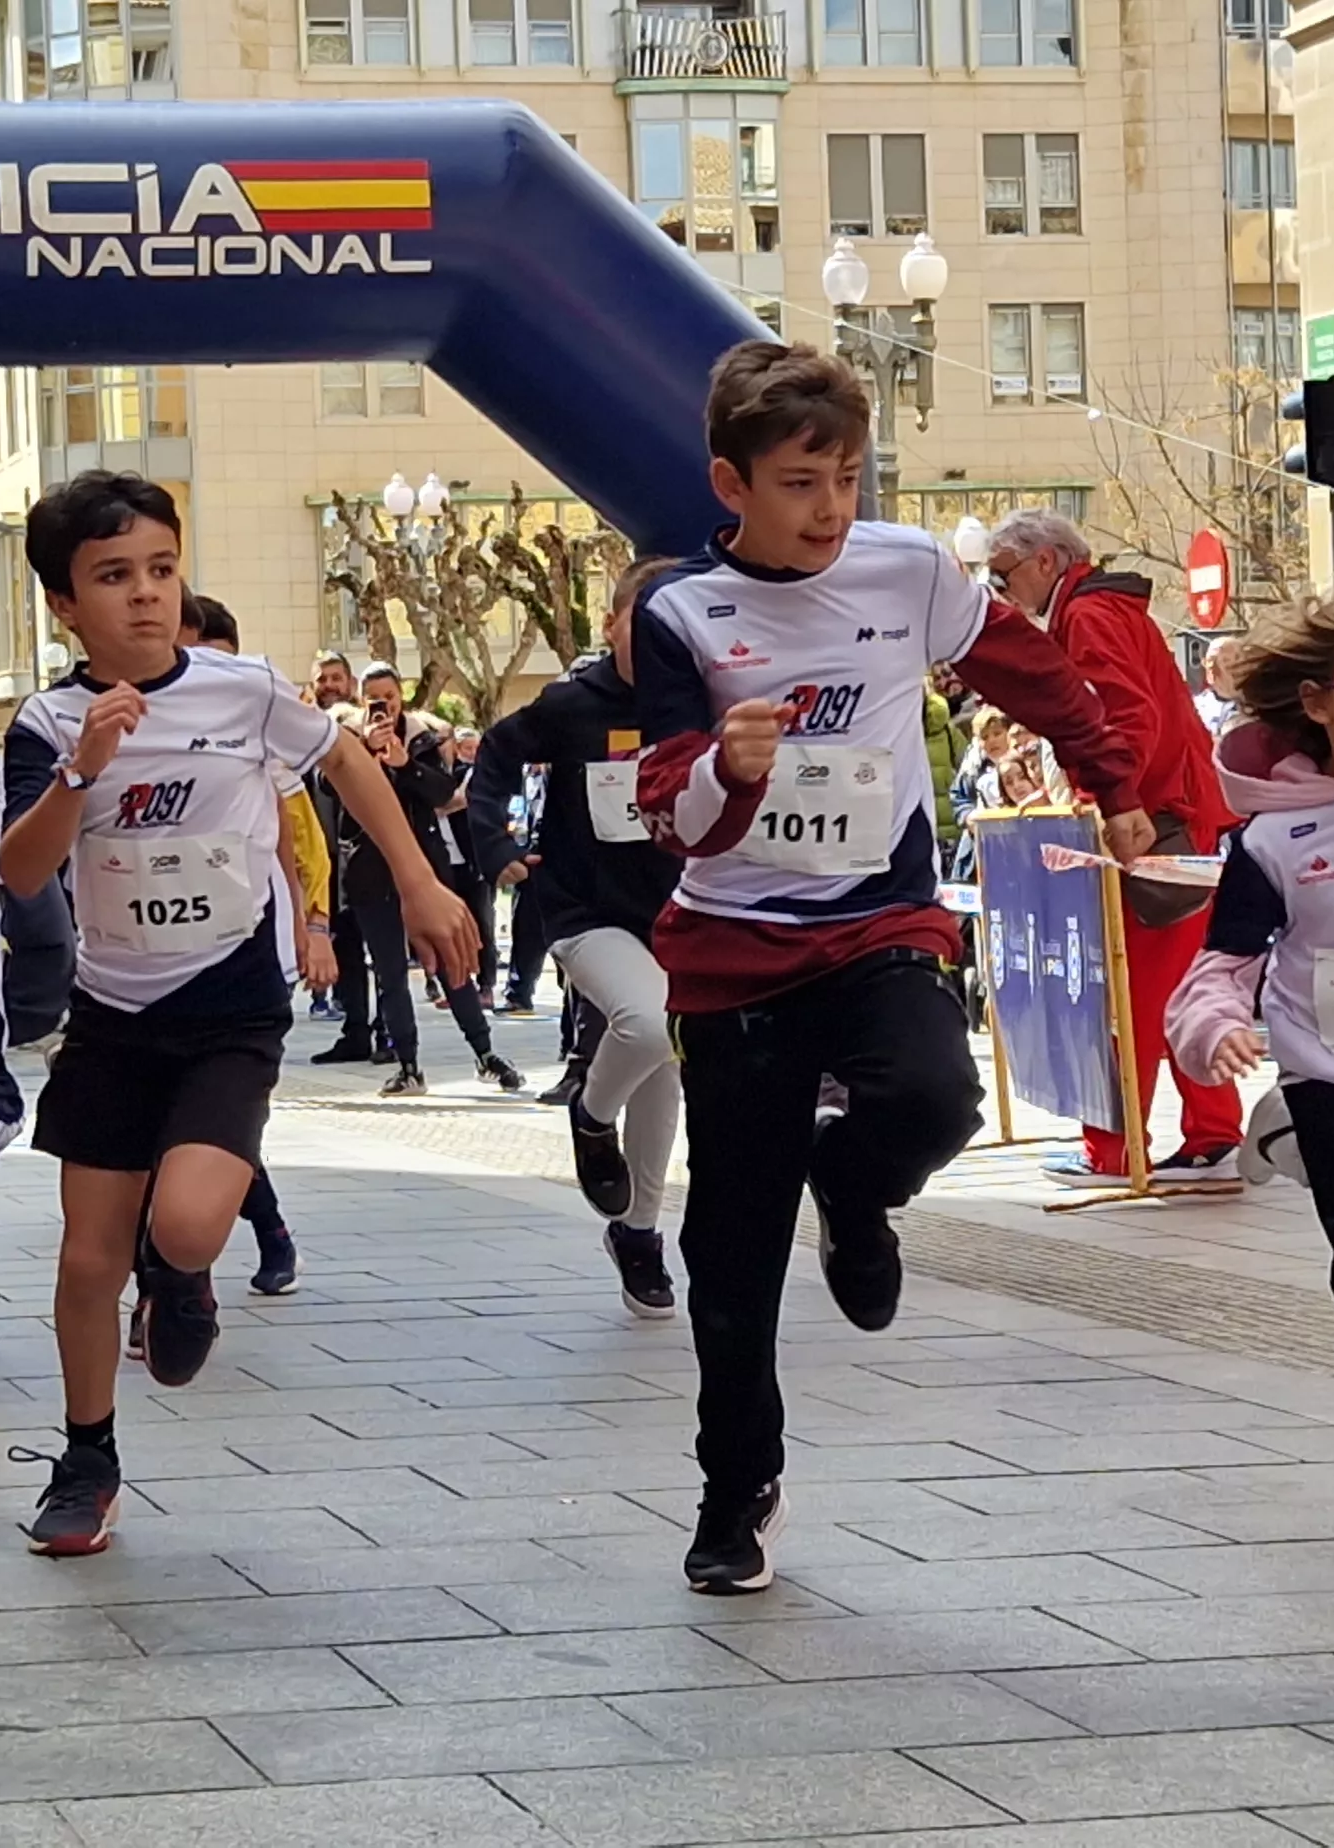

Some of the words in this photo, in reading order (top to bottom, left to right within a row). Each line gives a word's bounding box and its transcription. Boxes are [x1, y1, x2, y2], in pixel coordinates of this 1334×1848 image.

[27, 233, 436, 278] NACIONAL
[760, 811, 848, 843] 1011
[128, 895, 211, 925] 1025
